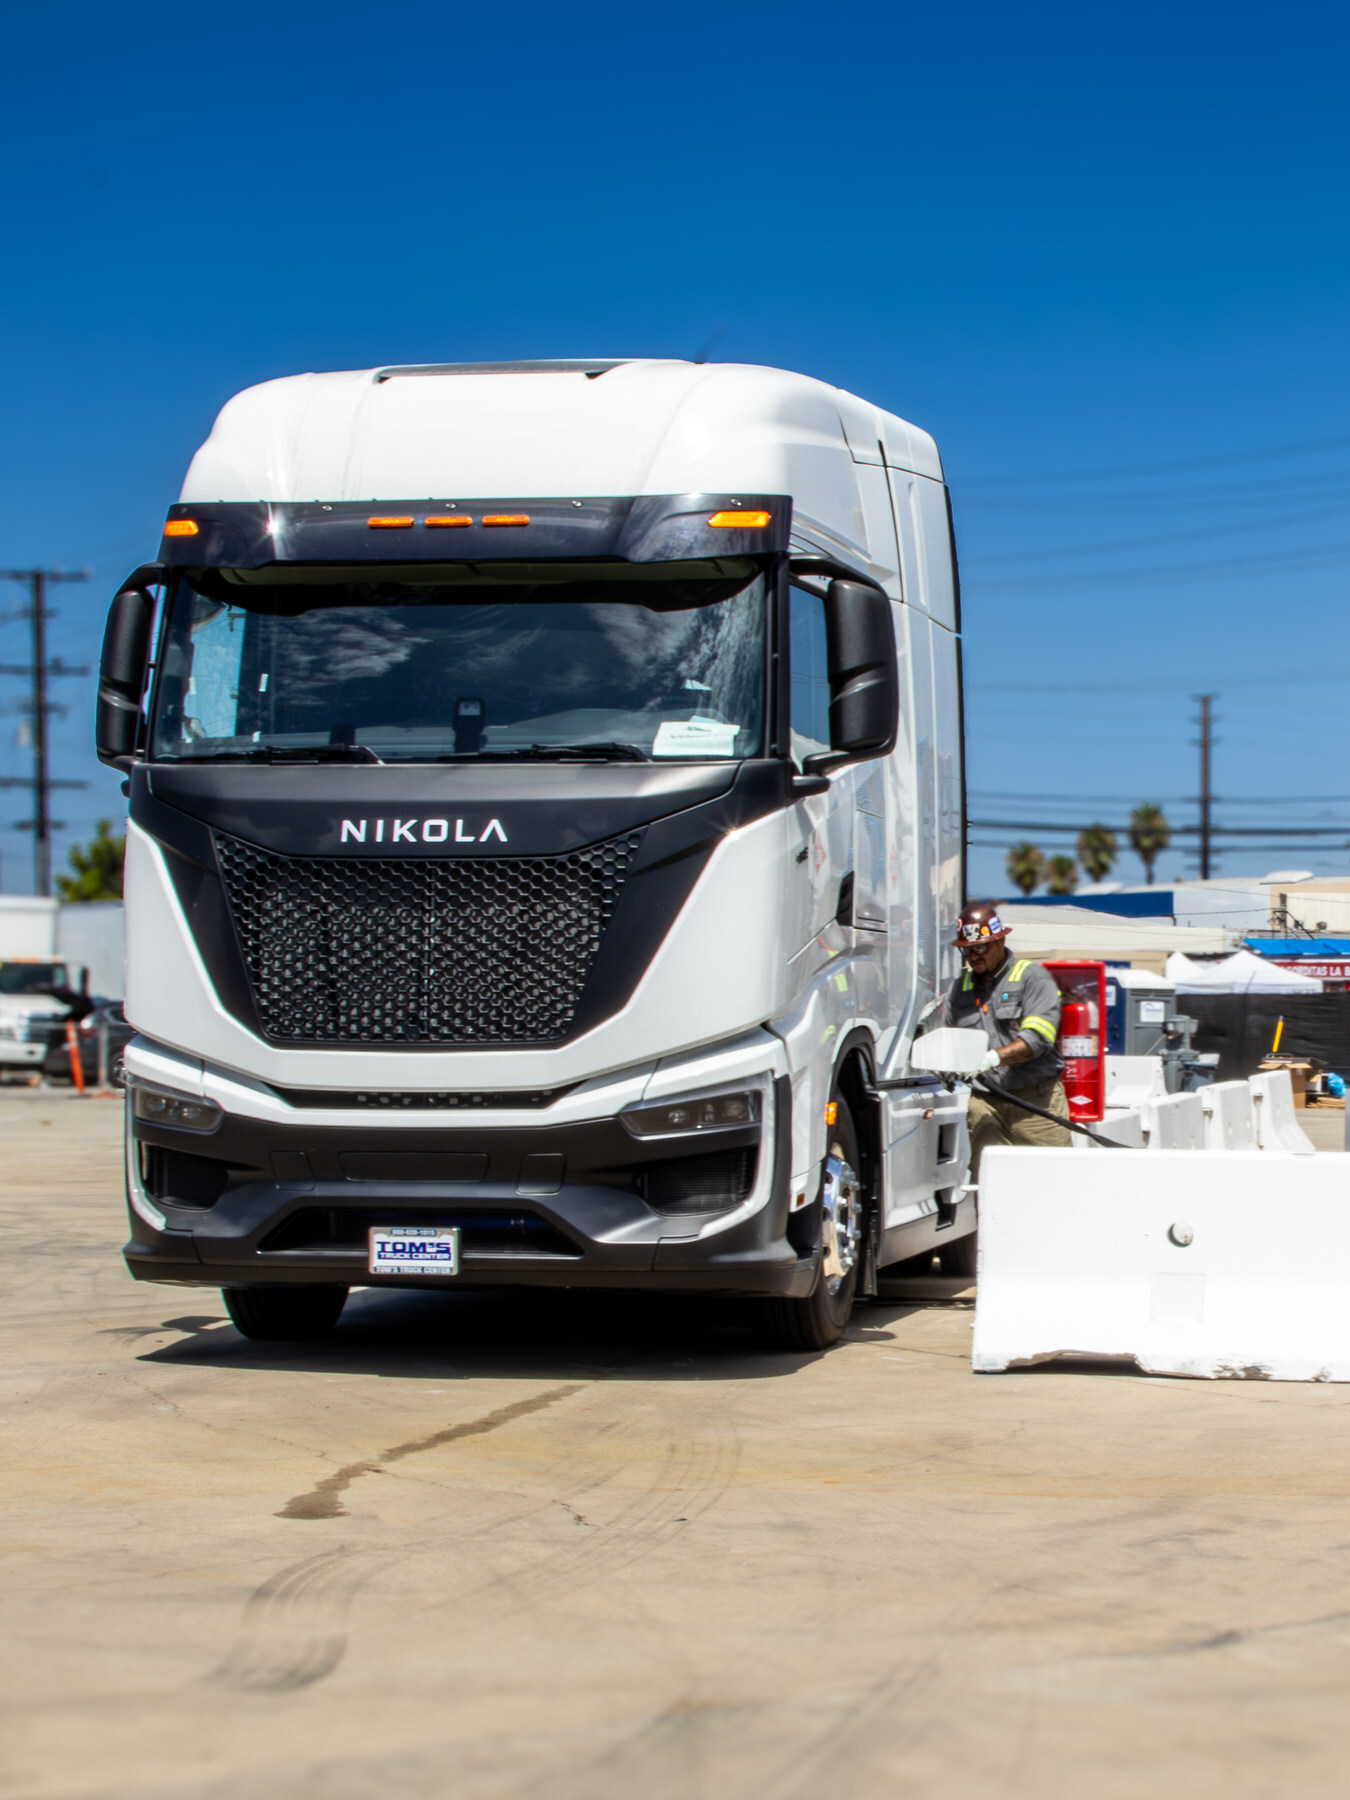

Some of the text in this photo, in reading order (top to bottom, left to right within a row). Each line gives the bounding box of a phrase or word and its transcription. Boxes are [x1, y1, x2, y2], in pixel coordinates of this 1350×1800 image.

[340, 819, 508, 843] NIKOLA
[1330, 966, 1342, 977] LA
[376, 1241, 451, 1253] TOM'S
